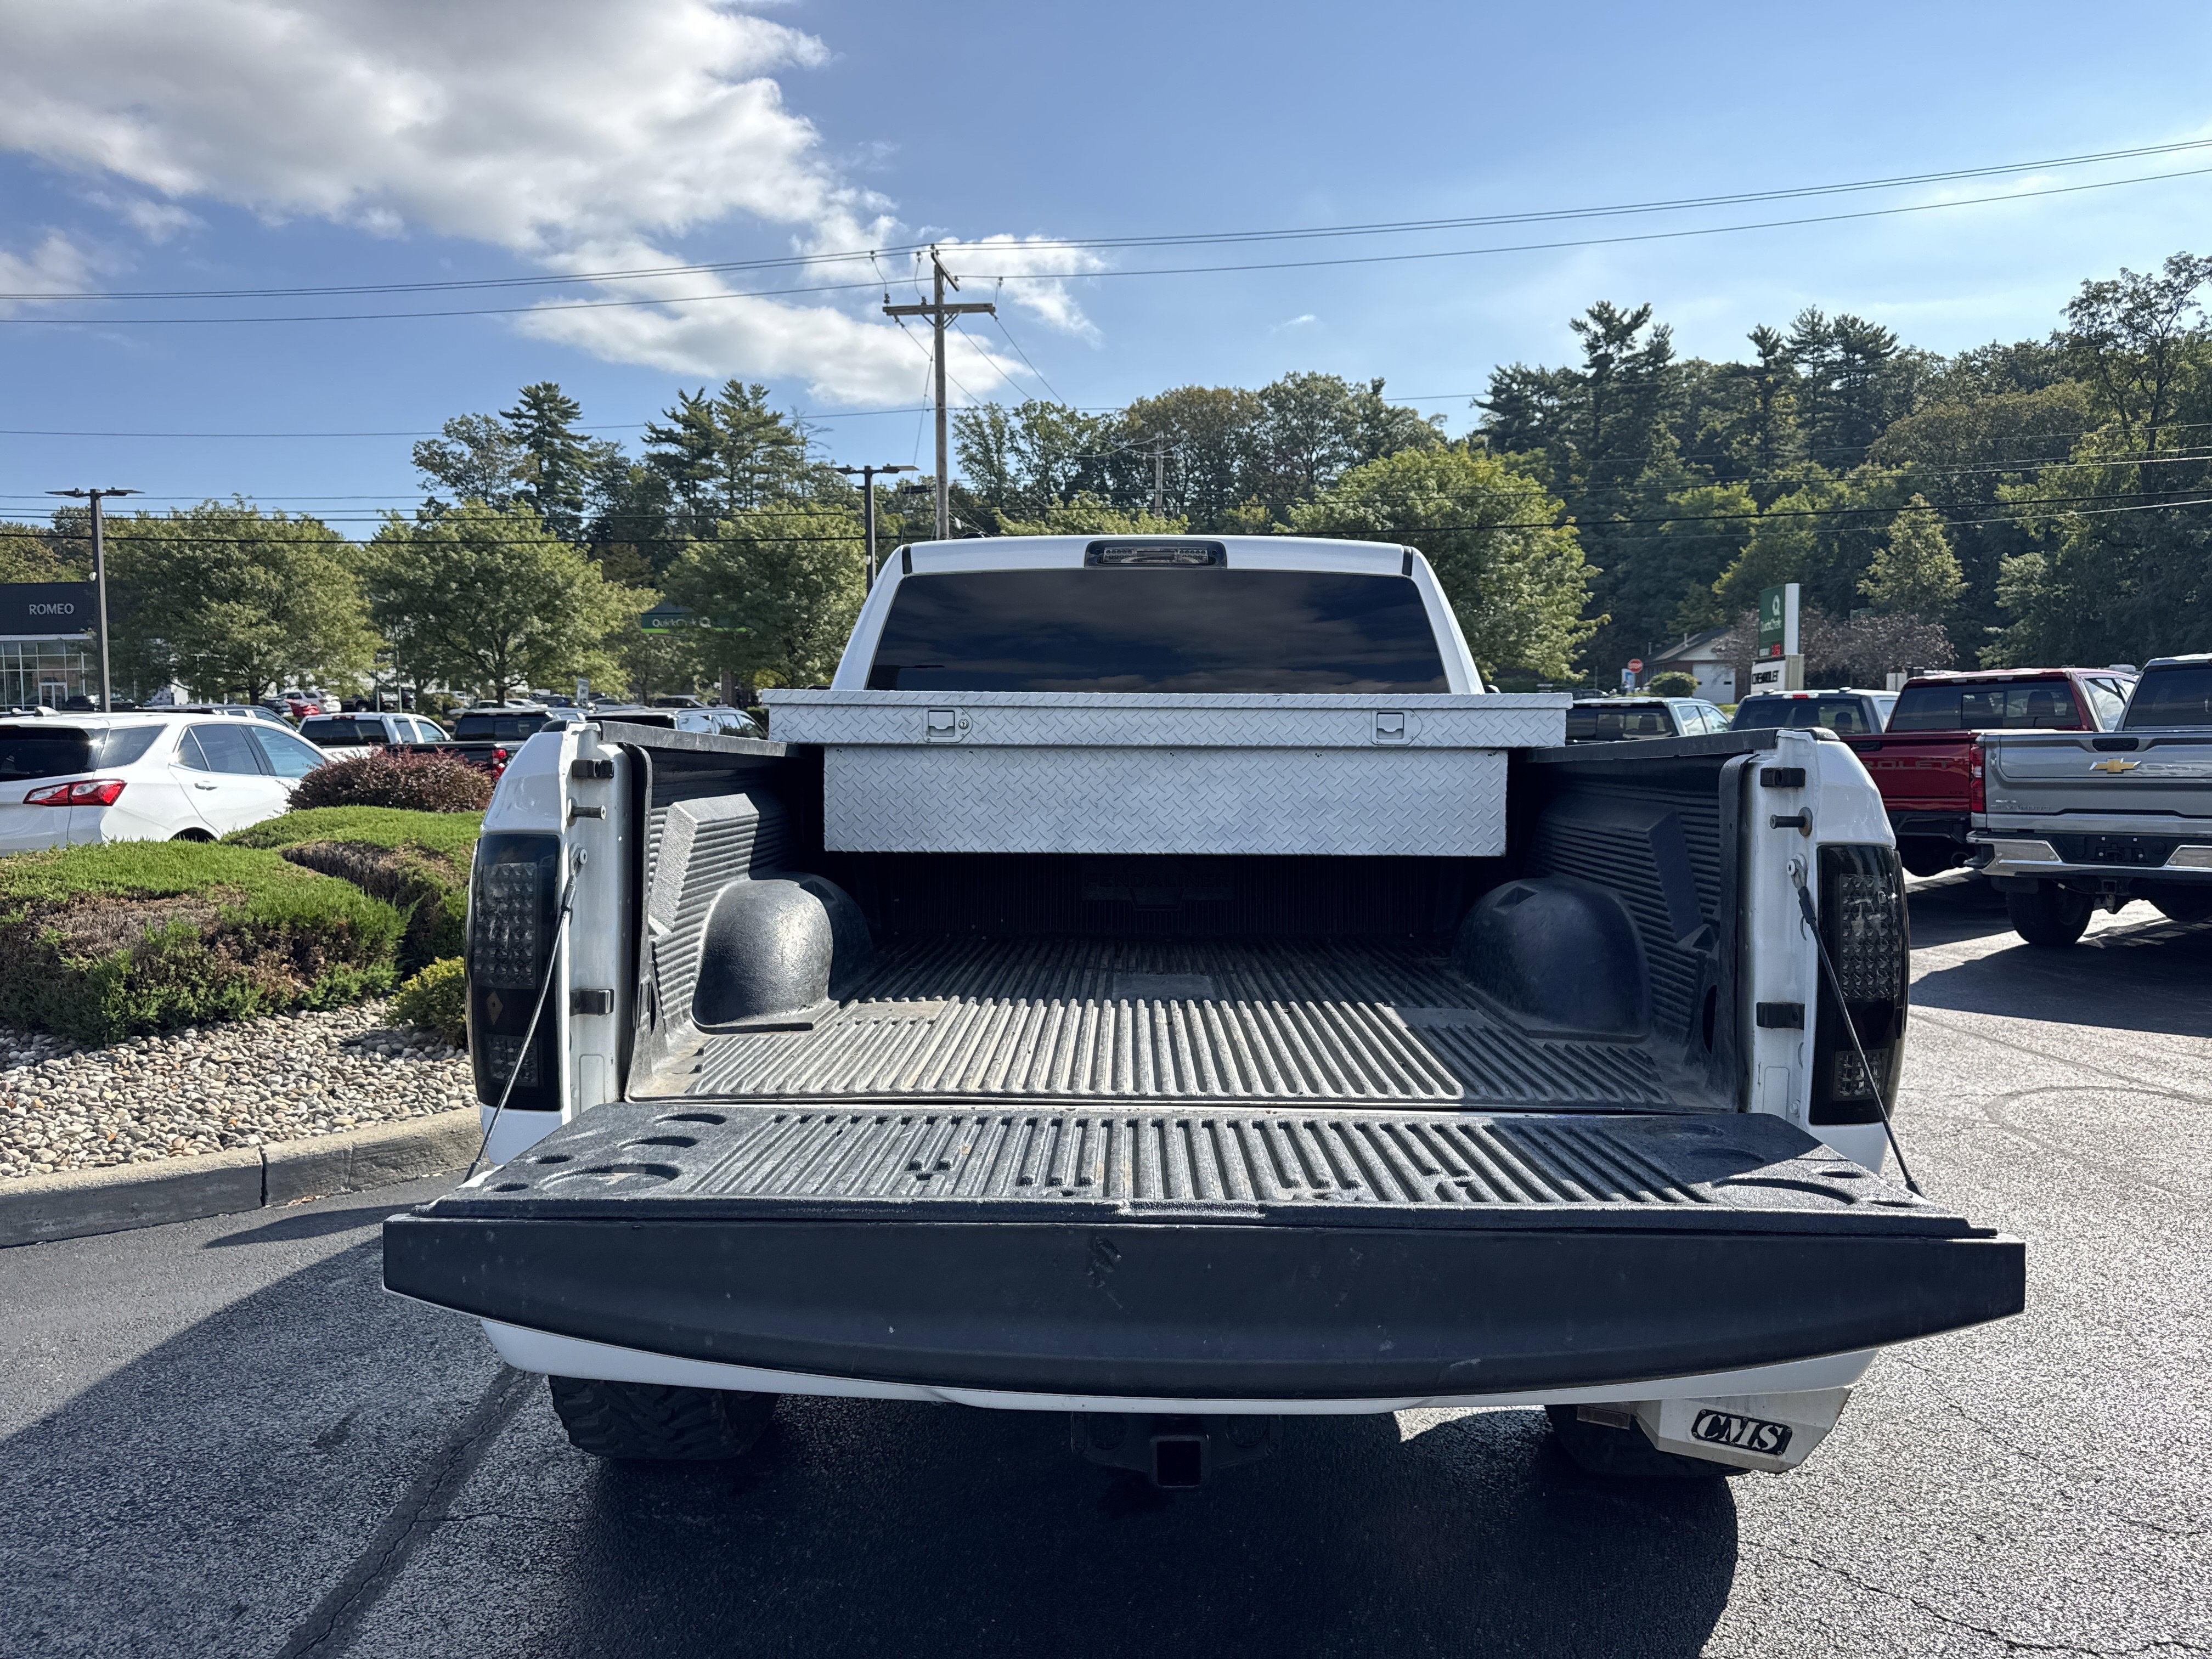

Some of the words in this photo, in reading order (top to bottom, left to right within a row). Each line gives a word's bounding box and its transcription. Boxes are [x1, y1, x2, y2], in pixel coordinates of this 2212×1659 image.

[29, 603, 75, 615] ROMEO
[652, 618, 697, 628] QuickCk
[1863, 760, 1953, 770] ROLET
[1084, 873, 1230, 887] PENDALINER
[1697, 1413, 1784, 1451] CMS
